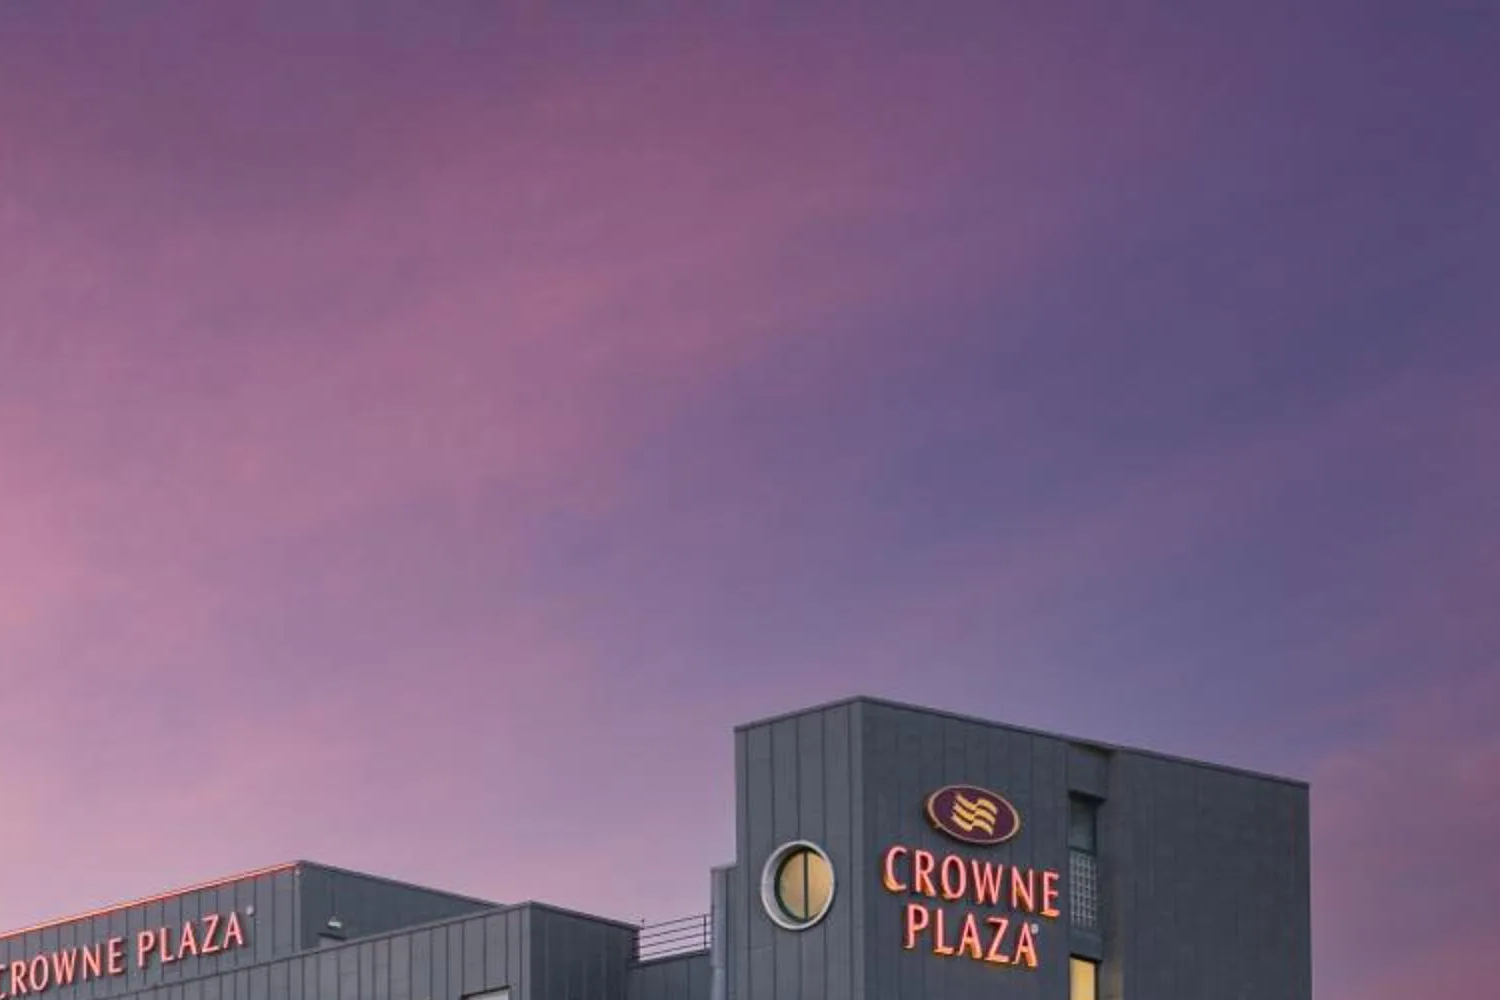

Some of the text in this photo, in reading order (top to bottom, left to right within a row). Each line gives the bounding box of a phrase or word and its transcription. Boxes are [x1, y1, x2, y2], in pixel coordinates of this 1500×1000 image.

[883, 845, 1061, 918] CROWNE
[136, 911, 244, 968] PLAZA
[903, 902, 1039, 968] PLAZA
